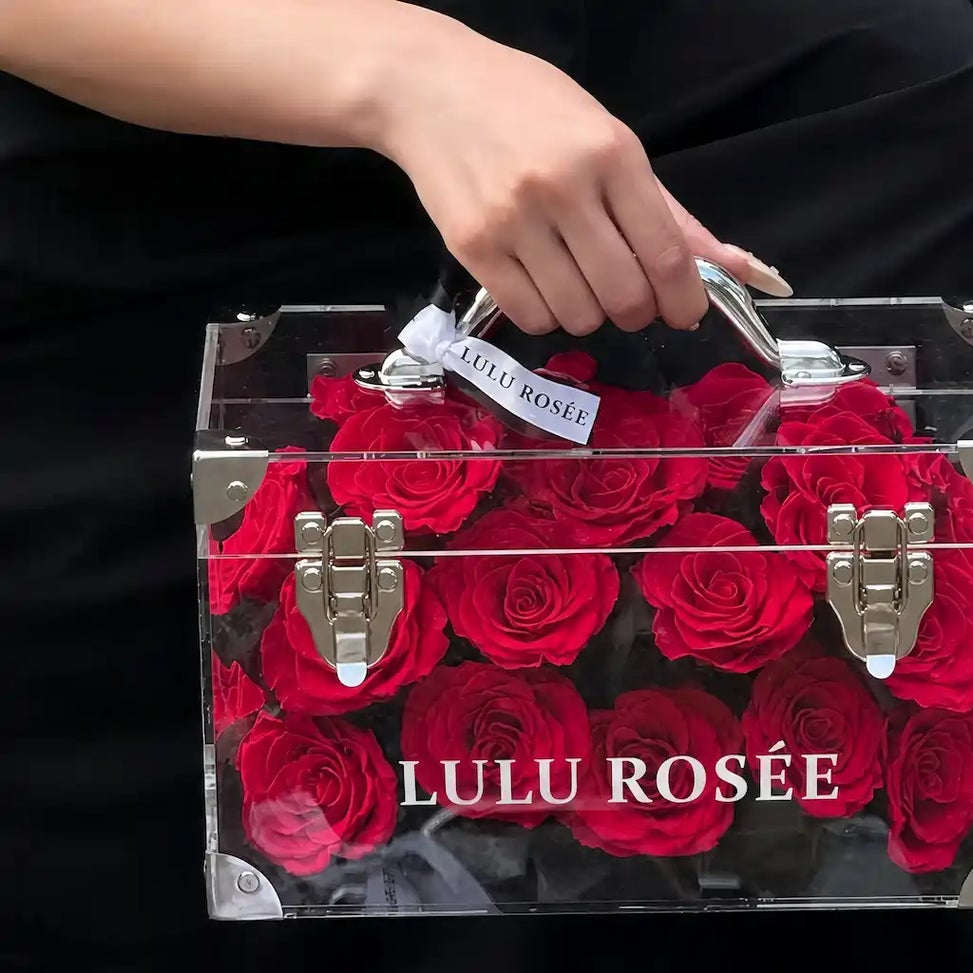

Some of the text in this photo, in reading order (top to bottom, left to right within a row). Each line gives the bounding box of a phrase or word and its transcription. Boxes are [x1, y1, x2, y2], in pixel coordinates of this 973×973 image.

[460, 346, 589, 426] LULU ROSÉE
[398, 740, 839, 806] LULU ROSÉE
